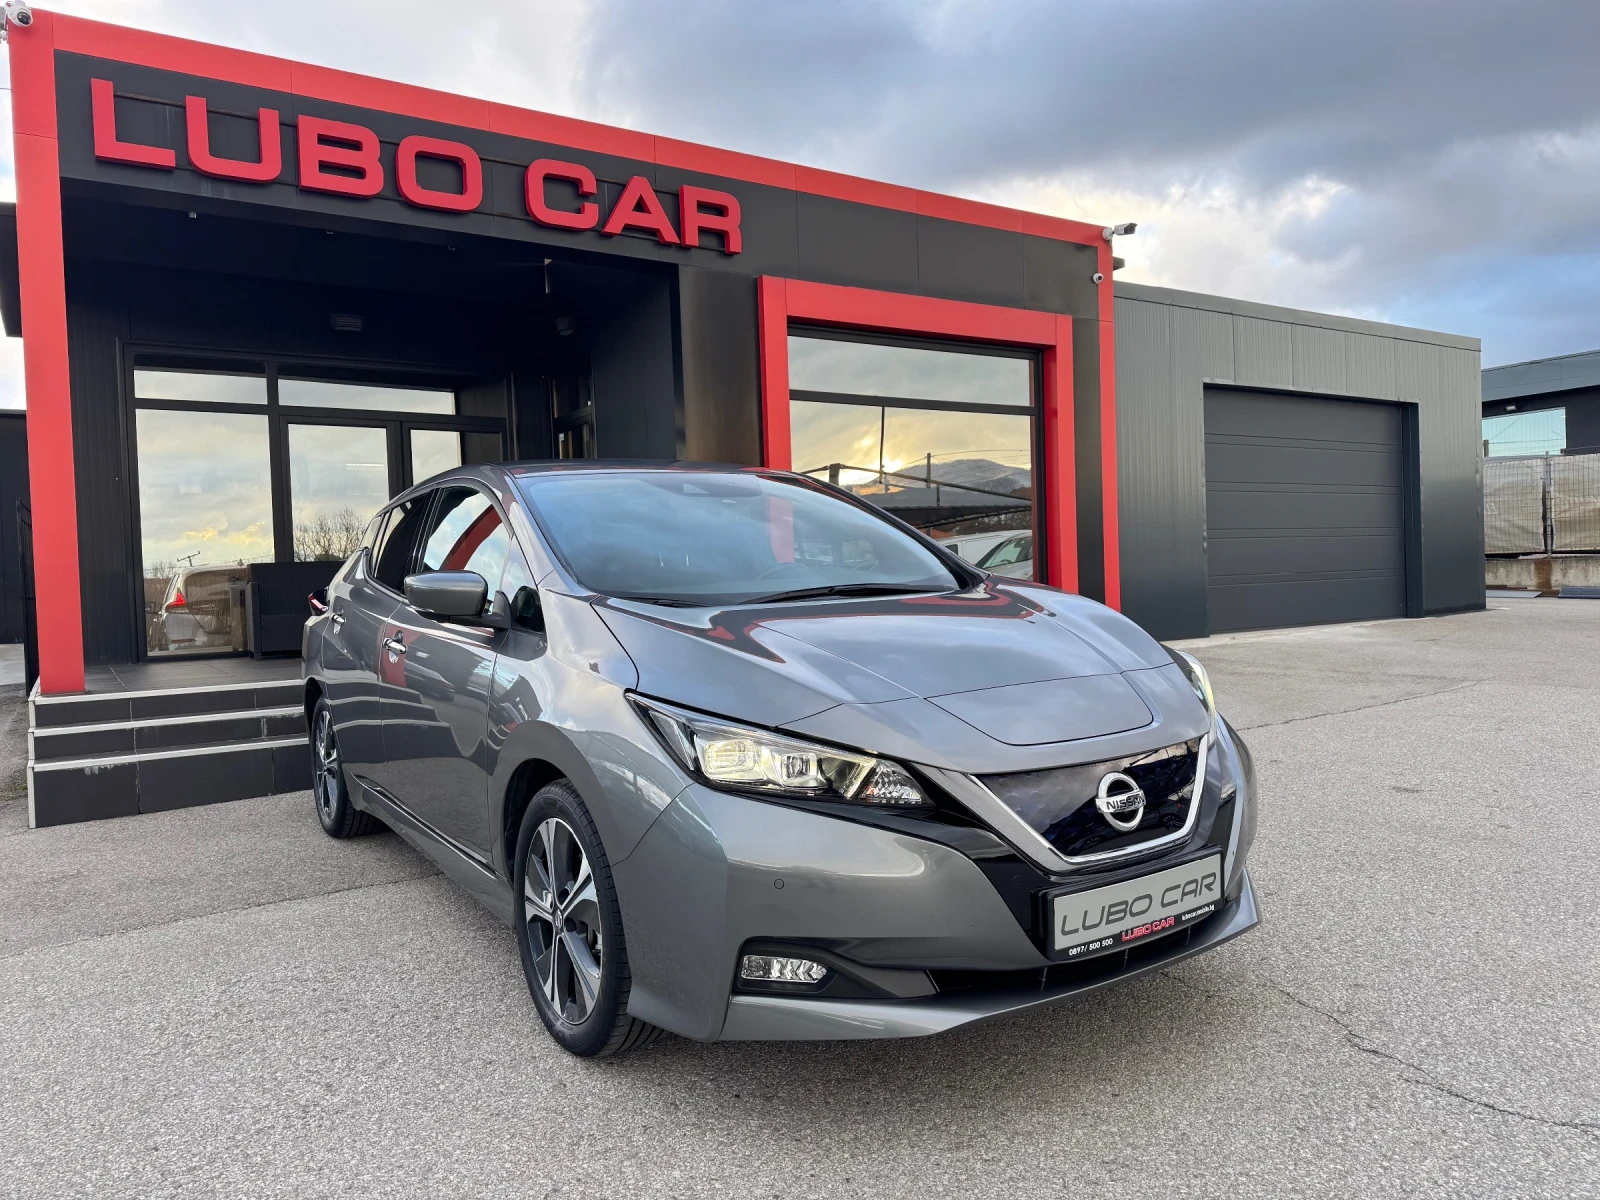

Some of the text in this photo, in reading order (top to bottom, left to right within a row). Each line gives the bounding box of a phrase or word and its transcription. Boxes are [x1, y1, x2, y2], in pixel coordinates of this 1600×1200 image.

[91, 78, 743, 255] LUBO CAR
[1061, 871, 1217, 936] LUBO CAR
[1068, 937, 1114, 956] 0897/ 500 500
[1121, 916, 1175, 942] LUBO CAR
